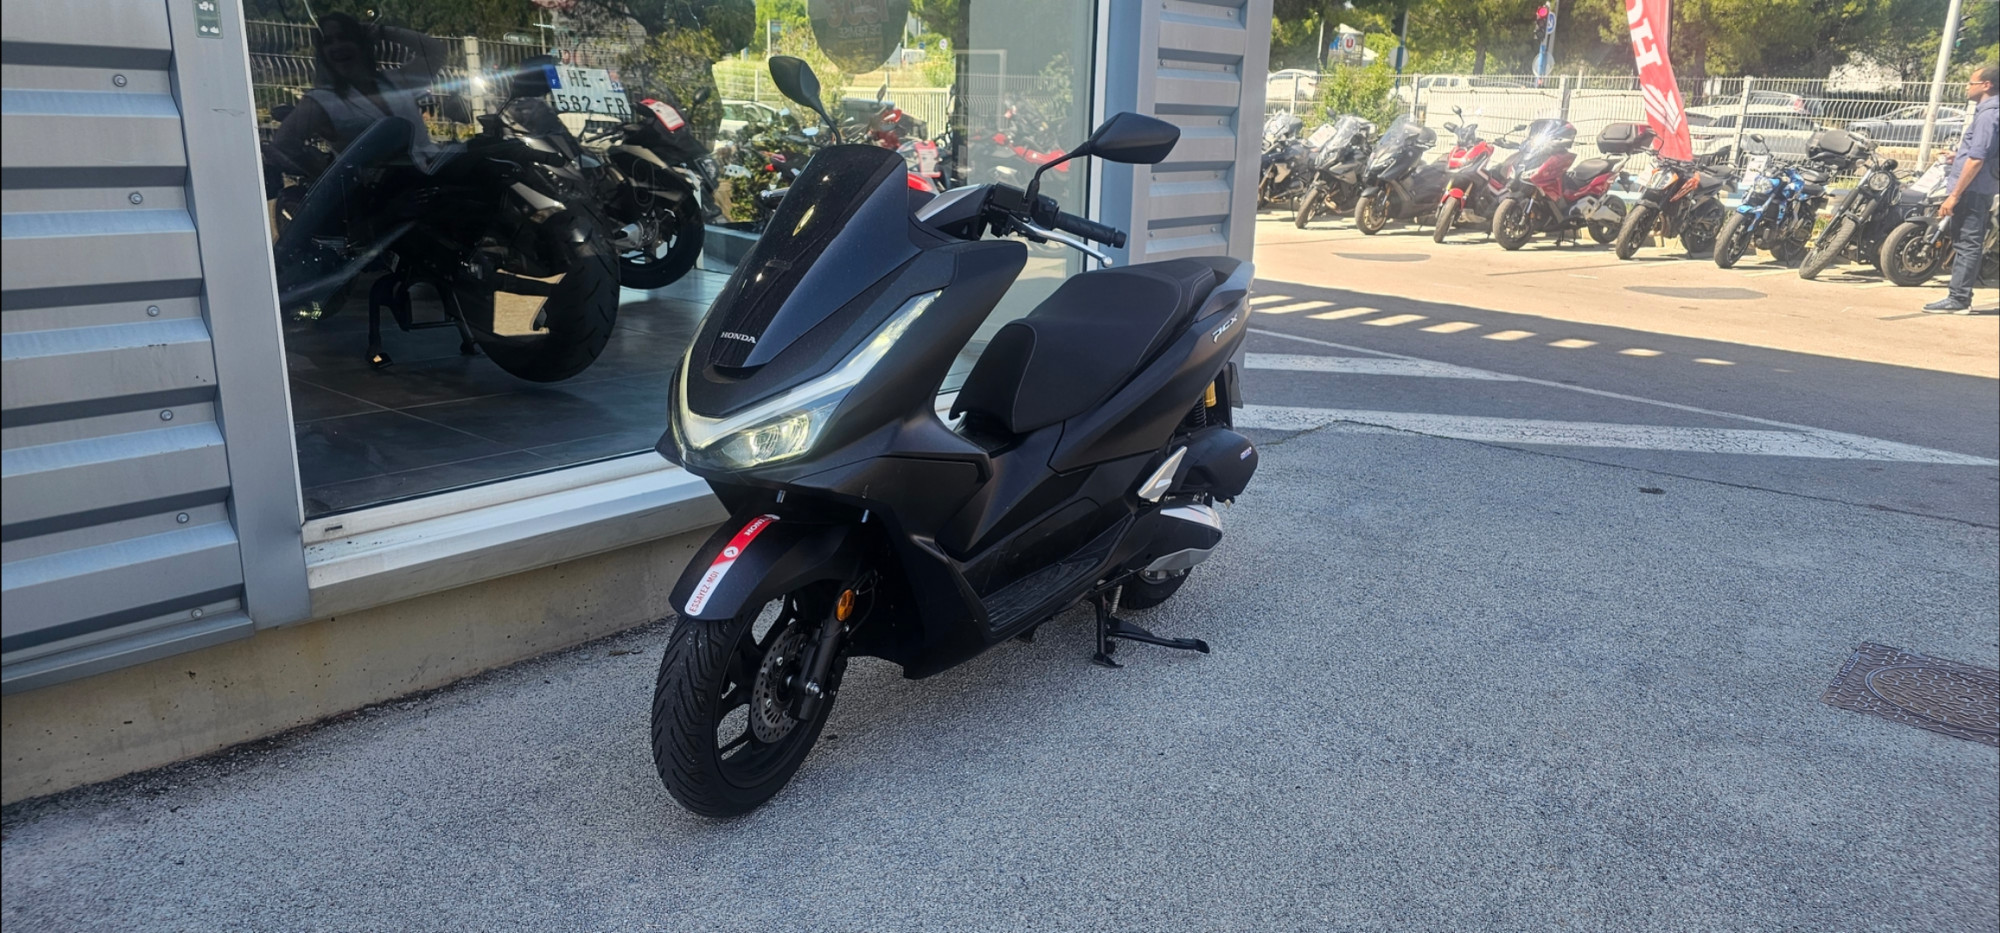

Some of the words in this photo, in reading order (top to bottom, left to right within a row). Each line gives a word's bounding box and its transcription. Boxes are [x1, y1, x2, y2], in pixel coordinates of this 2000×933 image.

[557, 94, 628, 115] 582-FR
[720, 331, 756, 344] HONDA
[1212, 313, 1238, 343] PCX
[689, 570, 720, 613] ESSAYEZ-MOI
